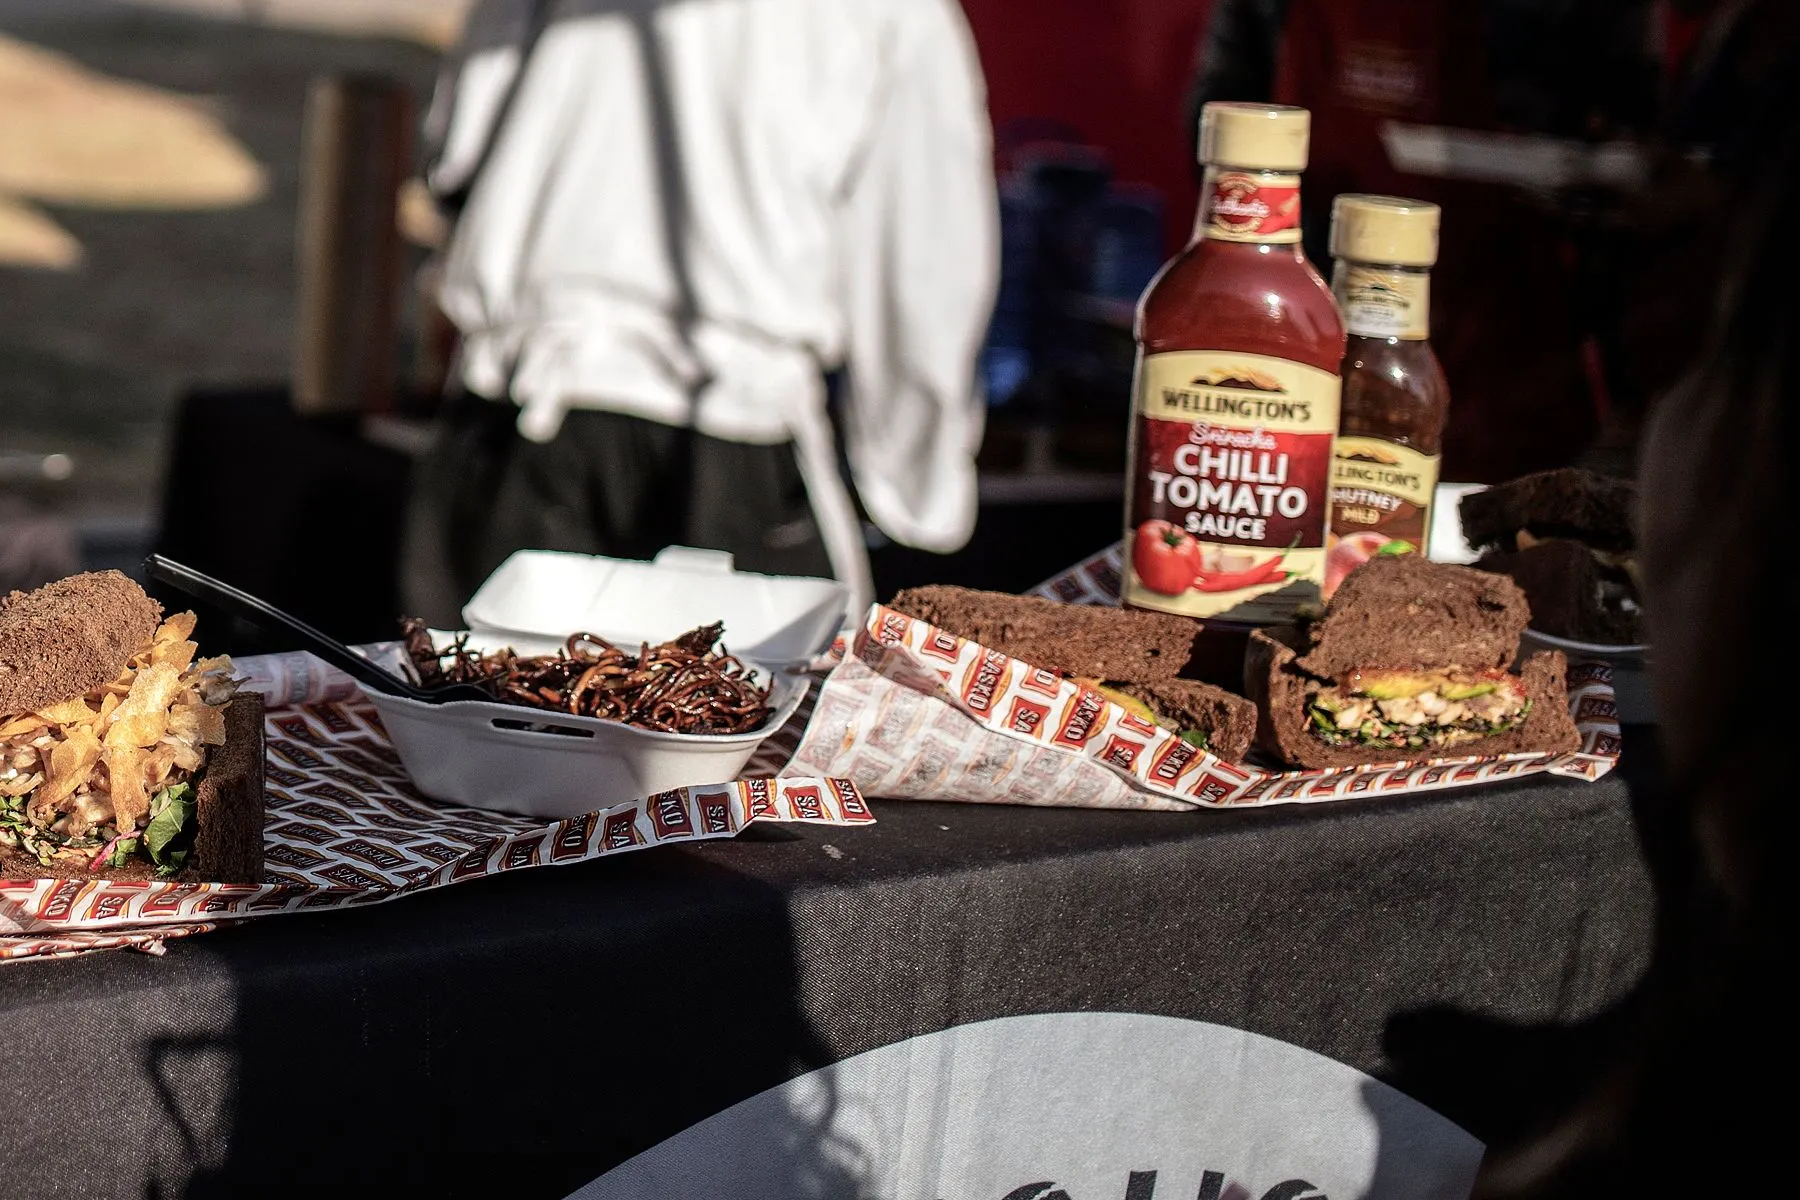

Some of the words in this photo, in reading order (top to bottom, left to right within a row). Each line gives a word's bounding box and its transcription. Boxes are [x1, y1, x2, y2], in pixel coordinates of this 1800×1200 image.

[1162, 388, 1311, 421] WELLINGTON'S
[1173, 443, 1288, 485] CHILLI
[1149, 470, 1308, 518] TOMATO
[1184, 511, 1267, 541] SAUCE
